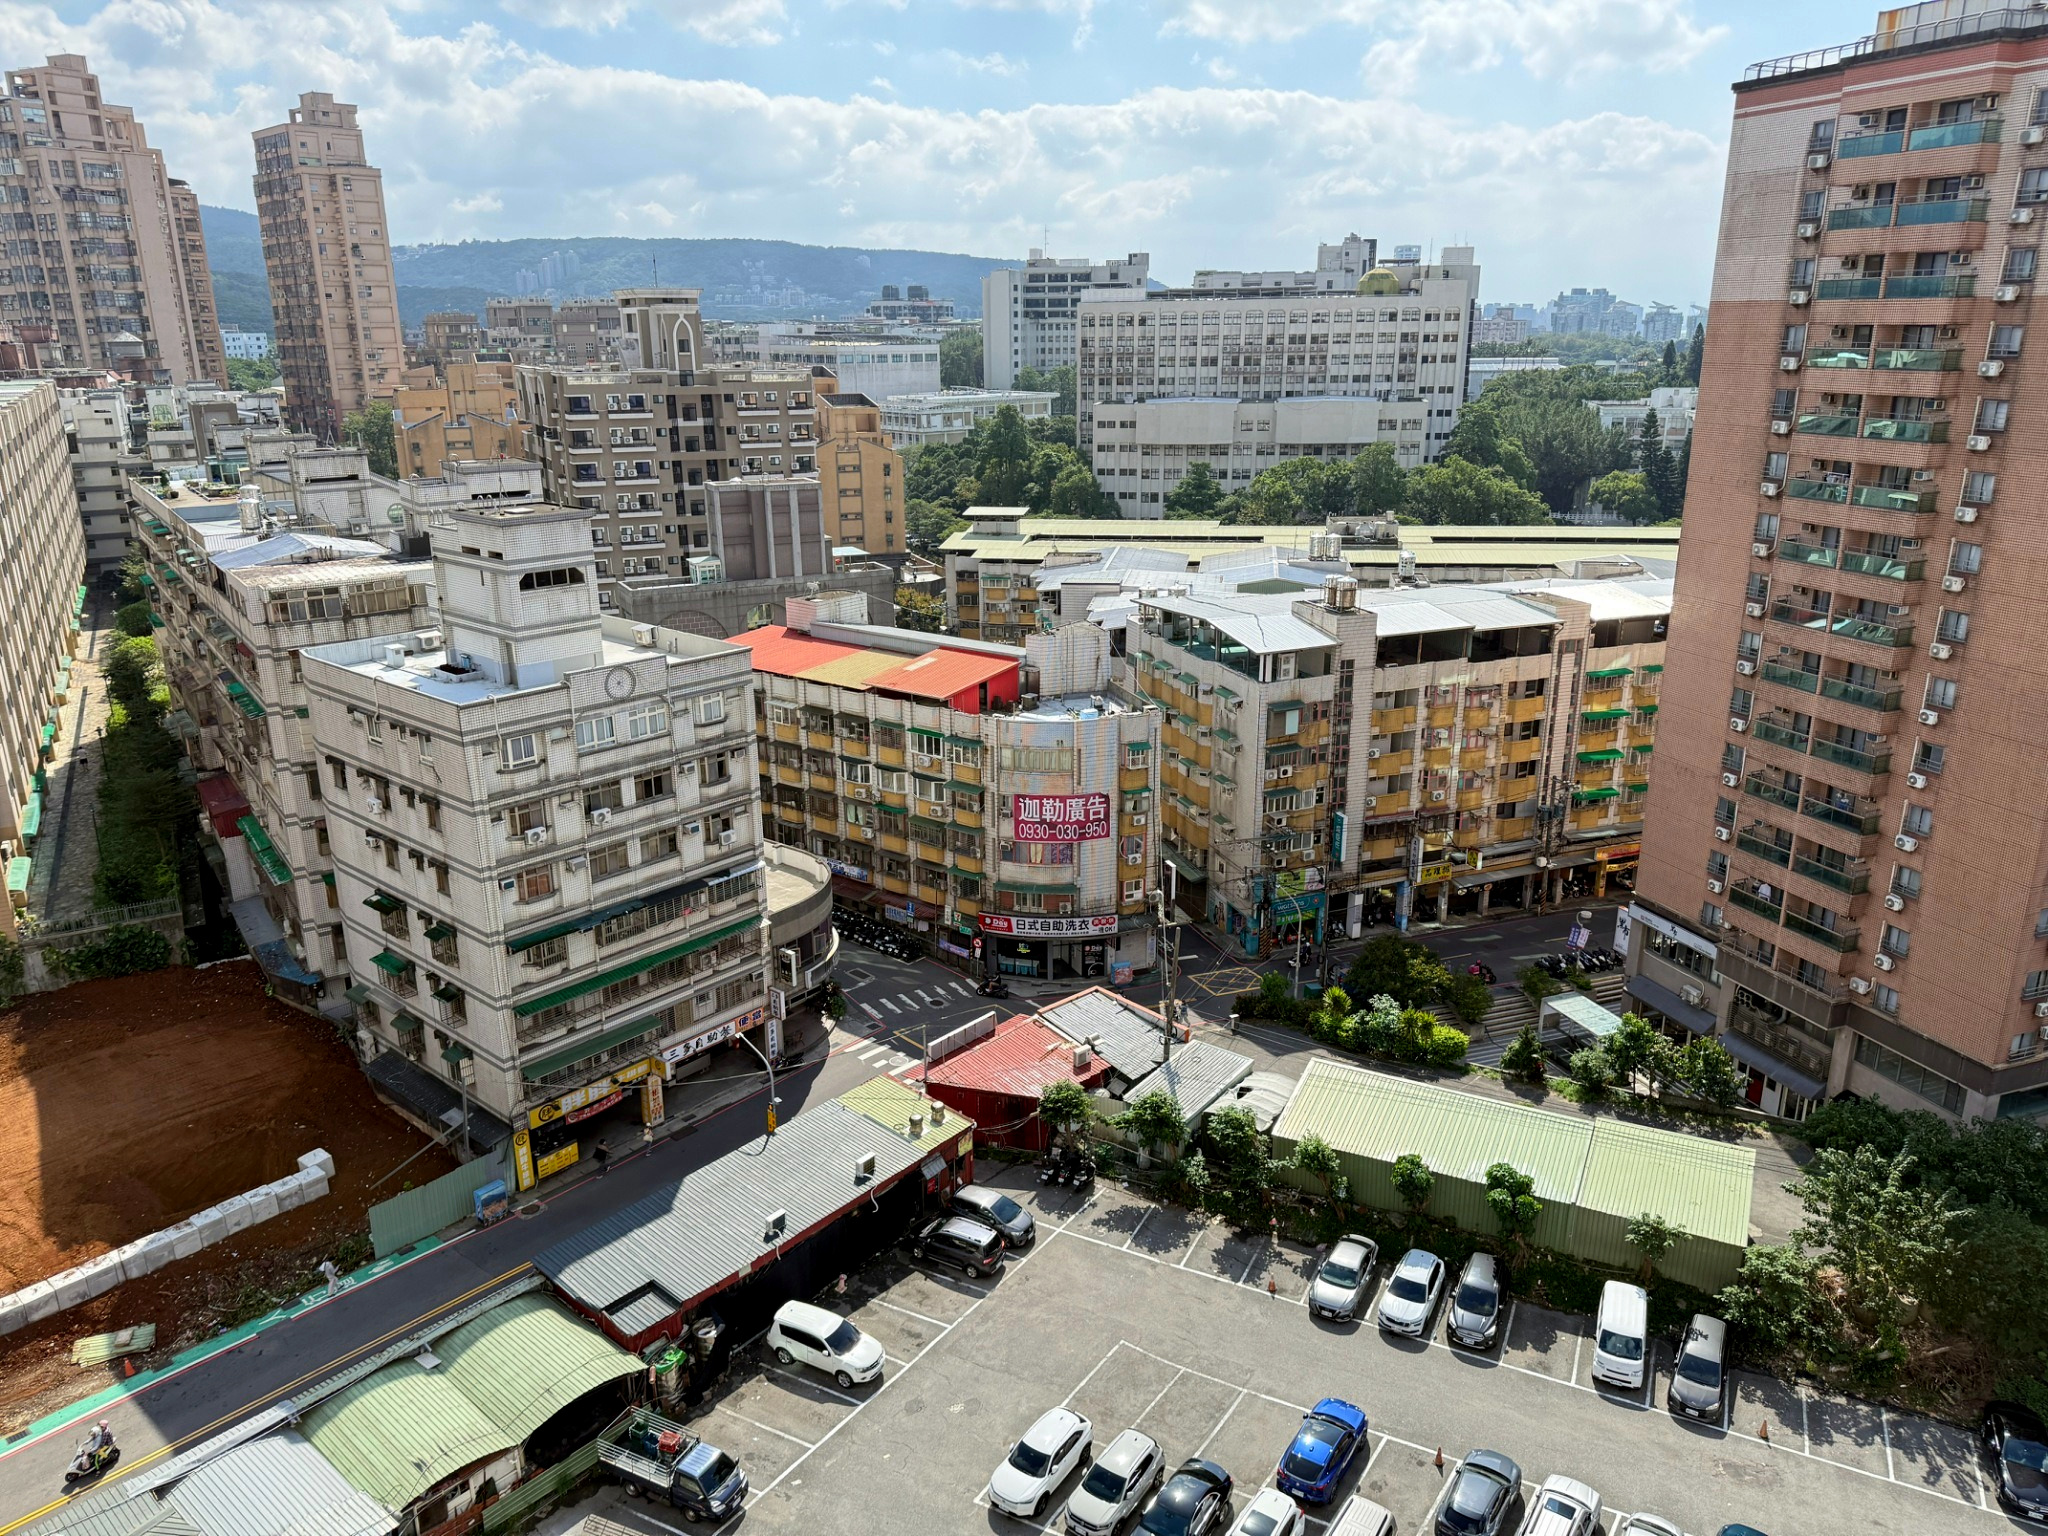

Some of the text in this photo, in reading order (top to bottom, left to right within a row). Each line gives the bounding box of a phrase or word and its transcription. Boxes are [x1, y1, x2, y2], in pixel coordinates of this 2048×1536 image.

[1019, 796, 1107, 823] 迦勒廣告
[1019, 821, 1107, 839] 0930-030-950
[1016, 919, 1090, 932] 日式自助洗衣
